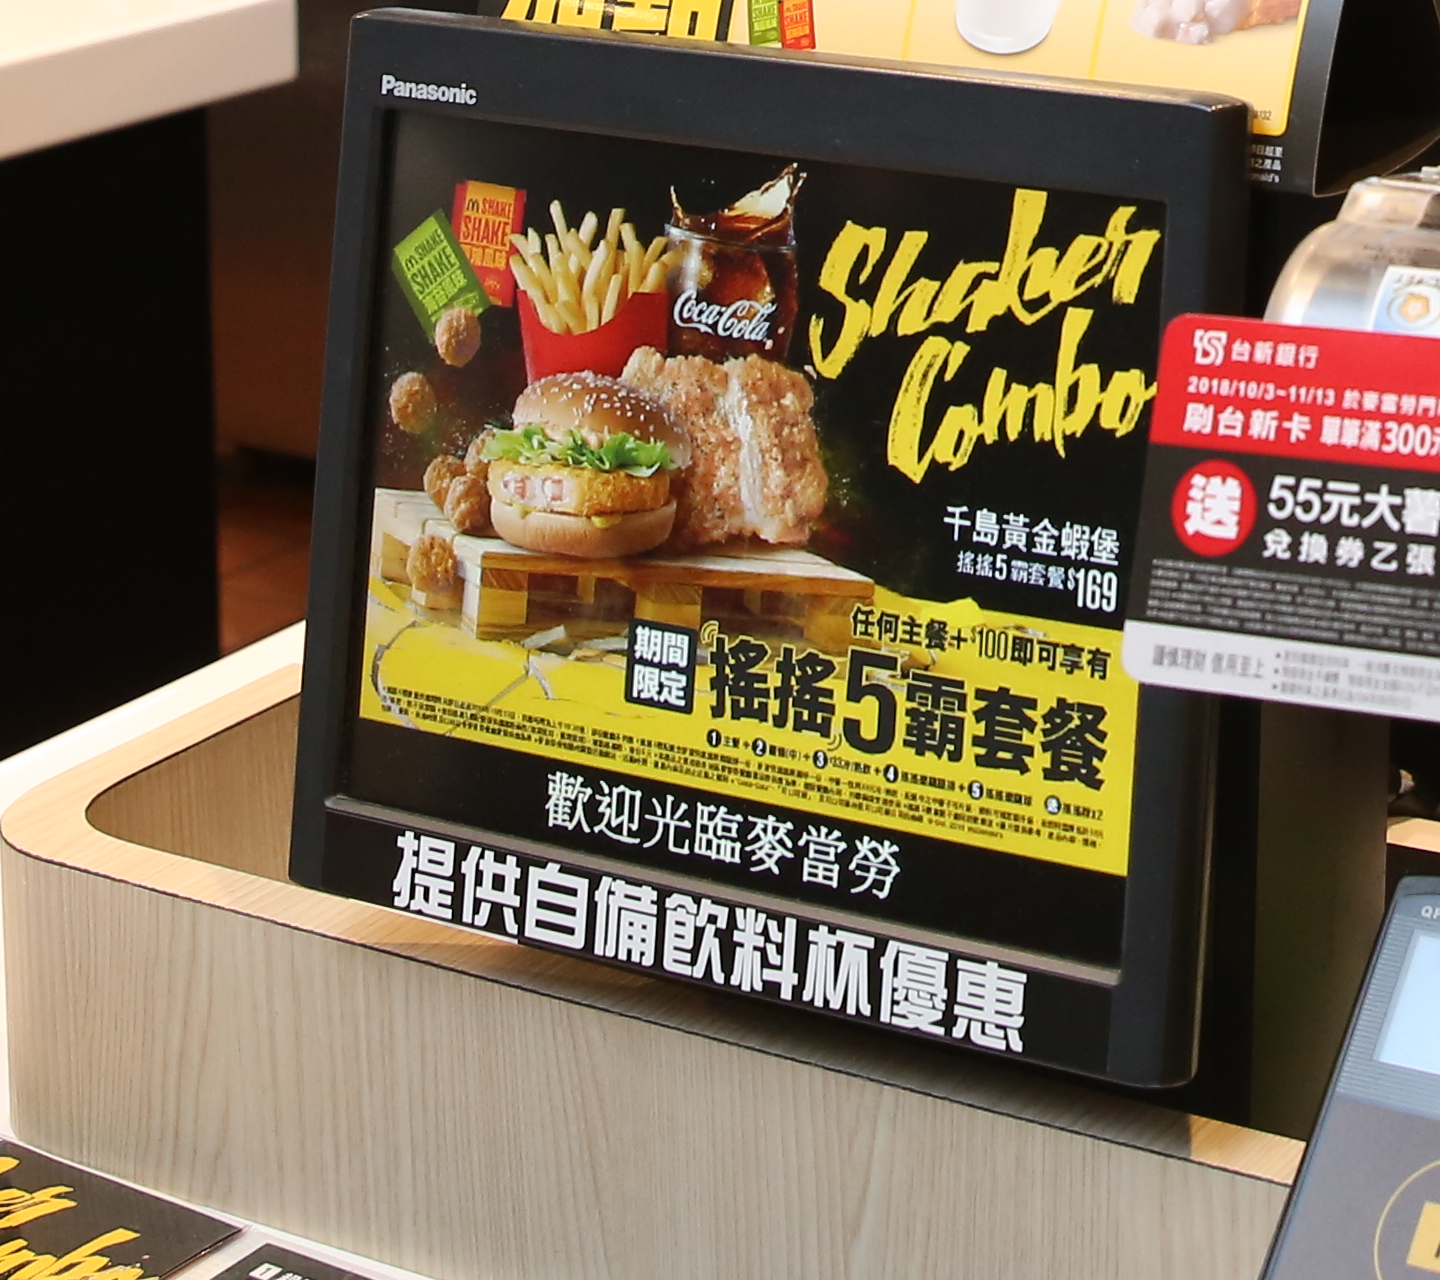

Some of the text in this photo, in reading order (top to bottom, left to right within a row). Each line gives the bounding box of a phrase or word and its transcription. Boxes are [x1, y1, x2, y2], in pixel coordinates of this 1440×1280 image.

[381, 74, 477, 106] Panasonic
[461, 215, 510, 248] SHAKE
[481, 197, 513, 220] SHAKE
[413, 227, 446, 260] SHAKE
[411, 245, 459, 296] SHAKE
[673, 290, 778, 343] Coca-Cola
[1230, 338, 1319, 369] 台新銀行
[886, 307, 1158, 485] Combo
[1182, 401, 1312, 443] 刷台新卡
[1184, 472, 1243, 541] 送
[943, 505, 1120, 566] 千島黃金蝦堡
[633, 624, 690, 670] 期間
[630, 666, 687, 708] 限定
[708, 631, 1108, 791] 搖搖5霸套餐
[545, 770, 901, 901] 歡迎光臨麥當勞
[391, 830, 1029, 1054] 提供自備飲料杯優惠
